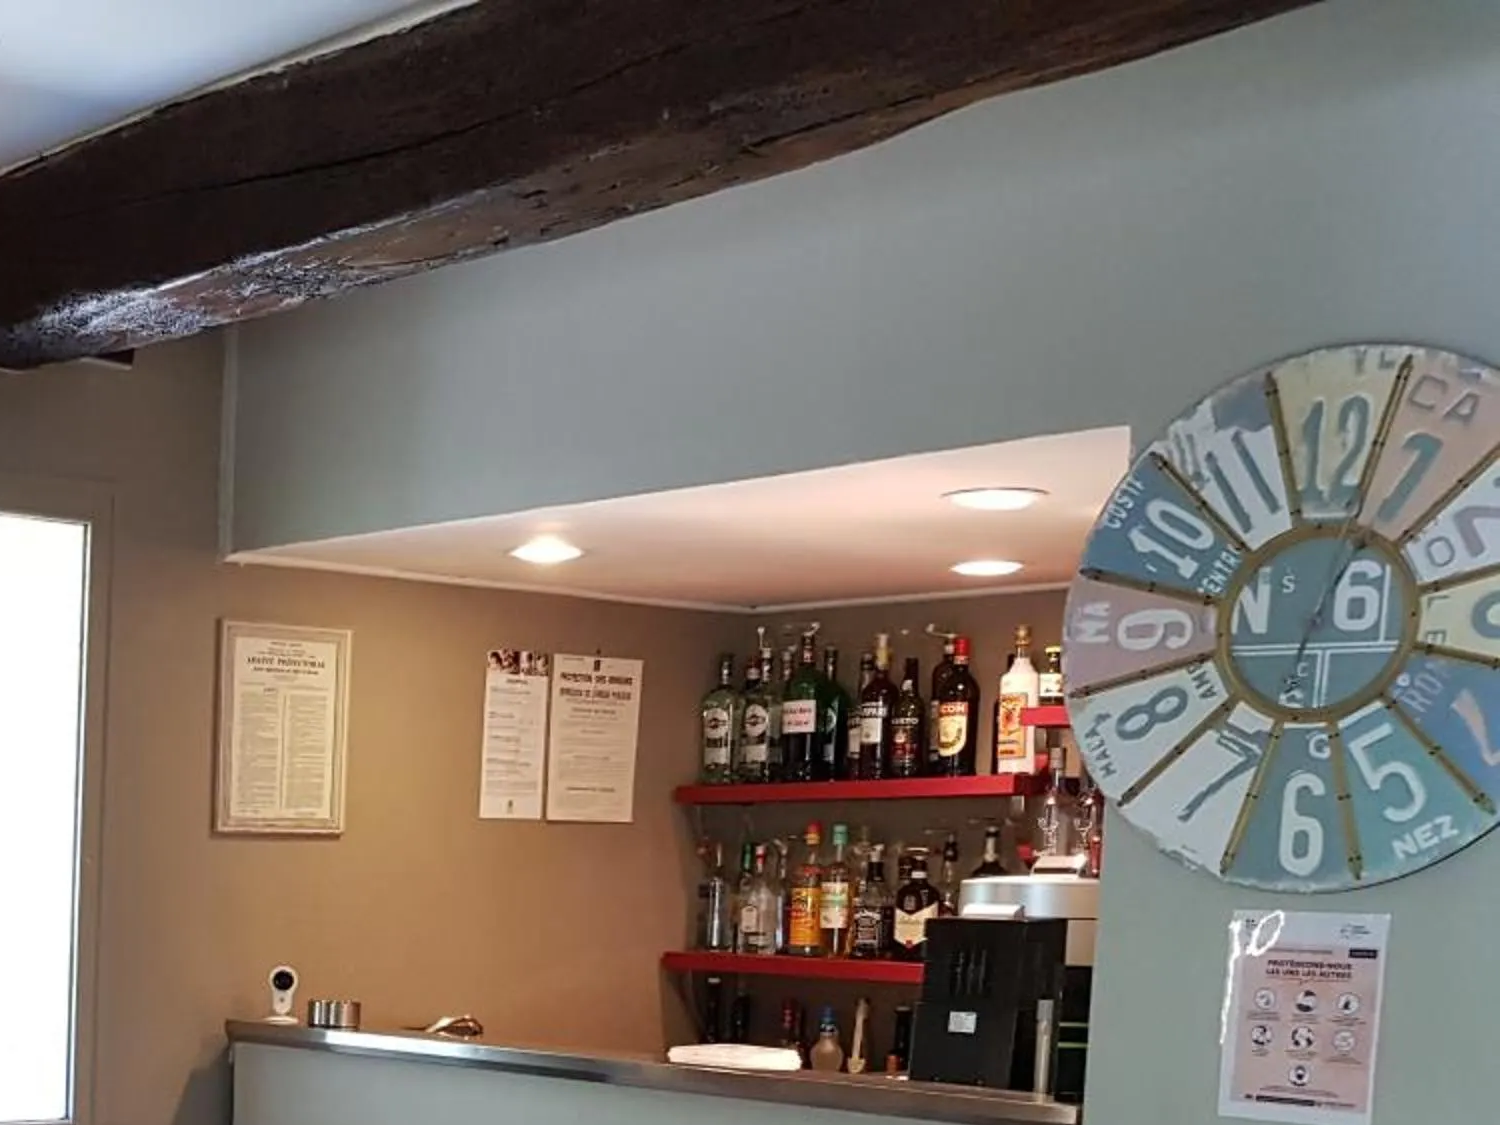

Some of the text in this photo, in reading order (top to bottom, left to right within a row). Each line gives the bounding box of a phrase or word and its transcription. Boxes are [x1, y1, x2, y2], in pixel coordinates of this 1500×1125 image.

[1302, 394, 1370, 505] 12
[1127, 498, 1216, 580] 10
[1116, 608, 1194, 650] 9
[1333, 559, 1384, 632] 6
[1115, 686, 1190, 741] 8
[1348, 721, 1427, 823] 5
[1279, 772, 1326, 878] 6
[1392, 814, 1460, 860] NEZ
